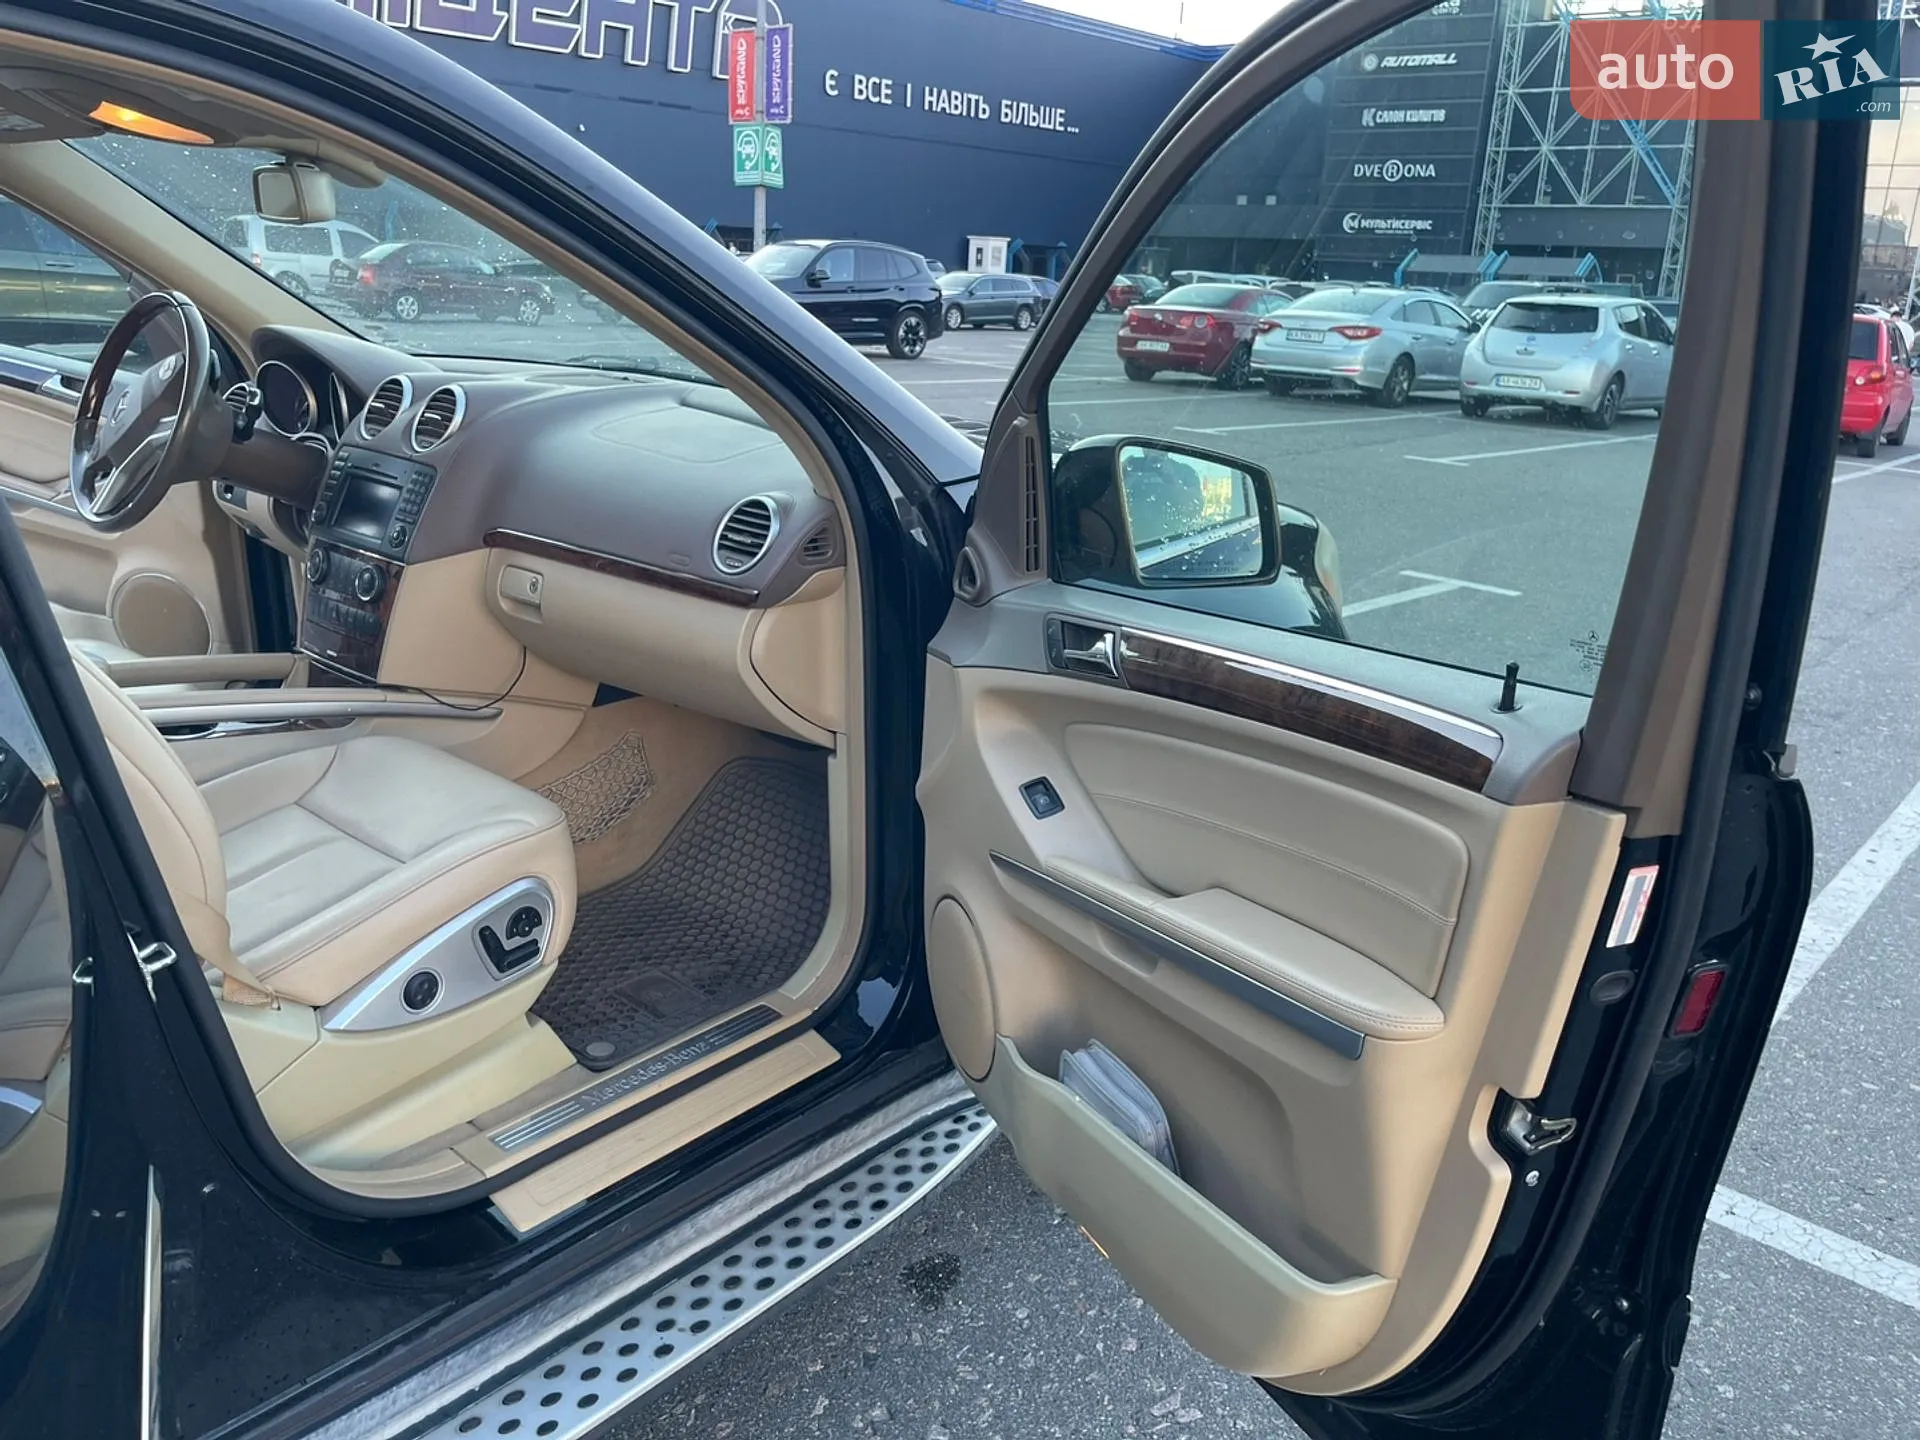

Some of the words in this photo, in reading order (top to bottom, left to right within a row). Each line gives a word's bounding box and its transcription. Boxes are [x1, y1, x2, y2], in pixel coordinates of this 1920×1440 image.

[1380, 52, 1458, 68] AUTOMALL
[824, 69, 839, 96] Є
[853, 74, 893, 105] ВСЕ
[905, 83, 912, 108] І
[924, 86, 991, 120] НАВІТЬ
[581, 1039, 711, 1107] Mercedes-Benz
